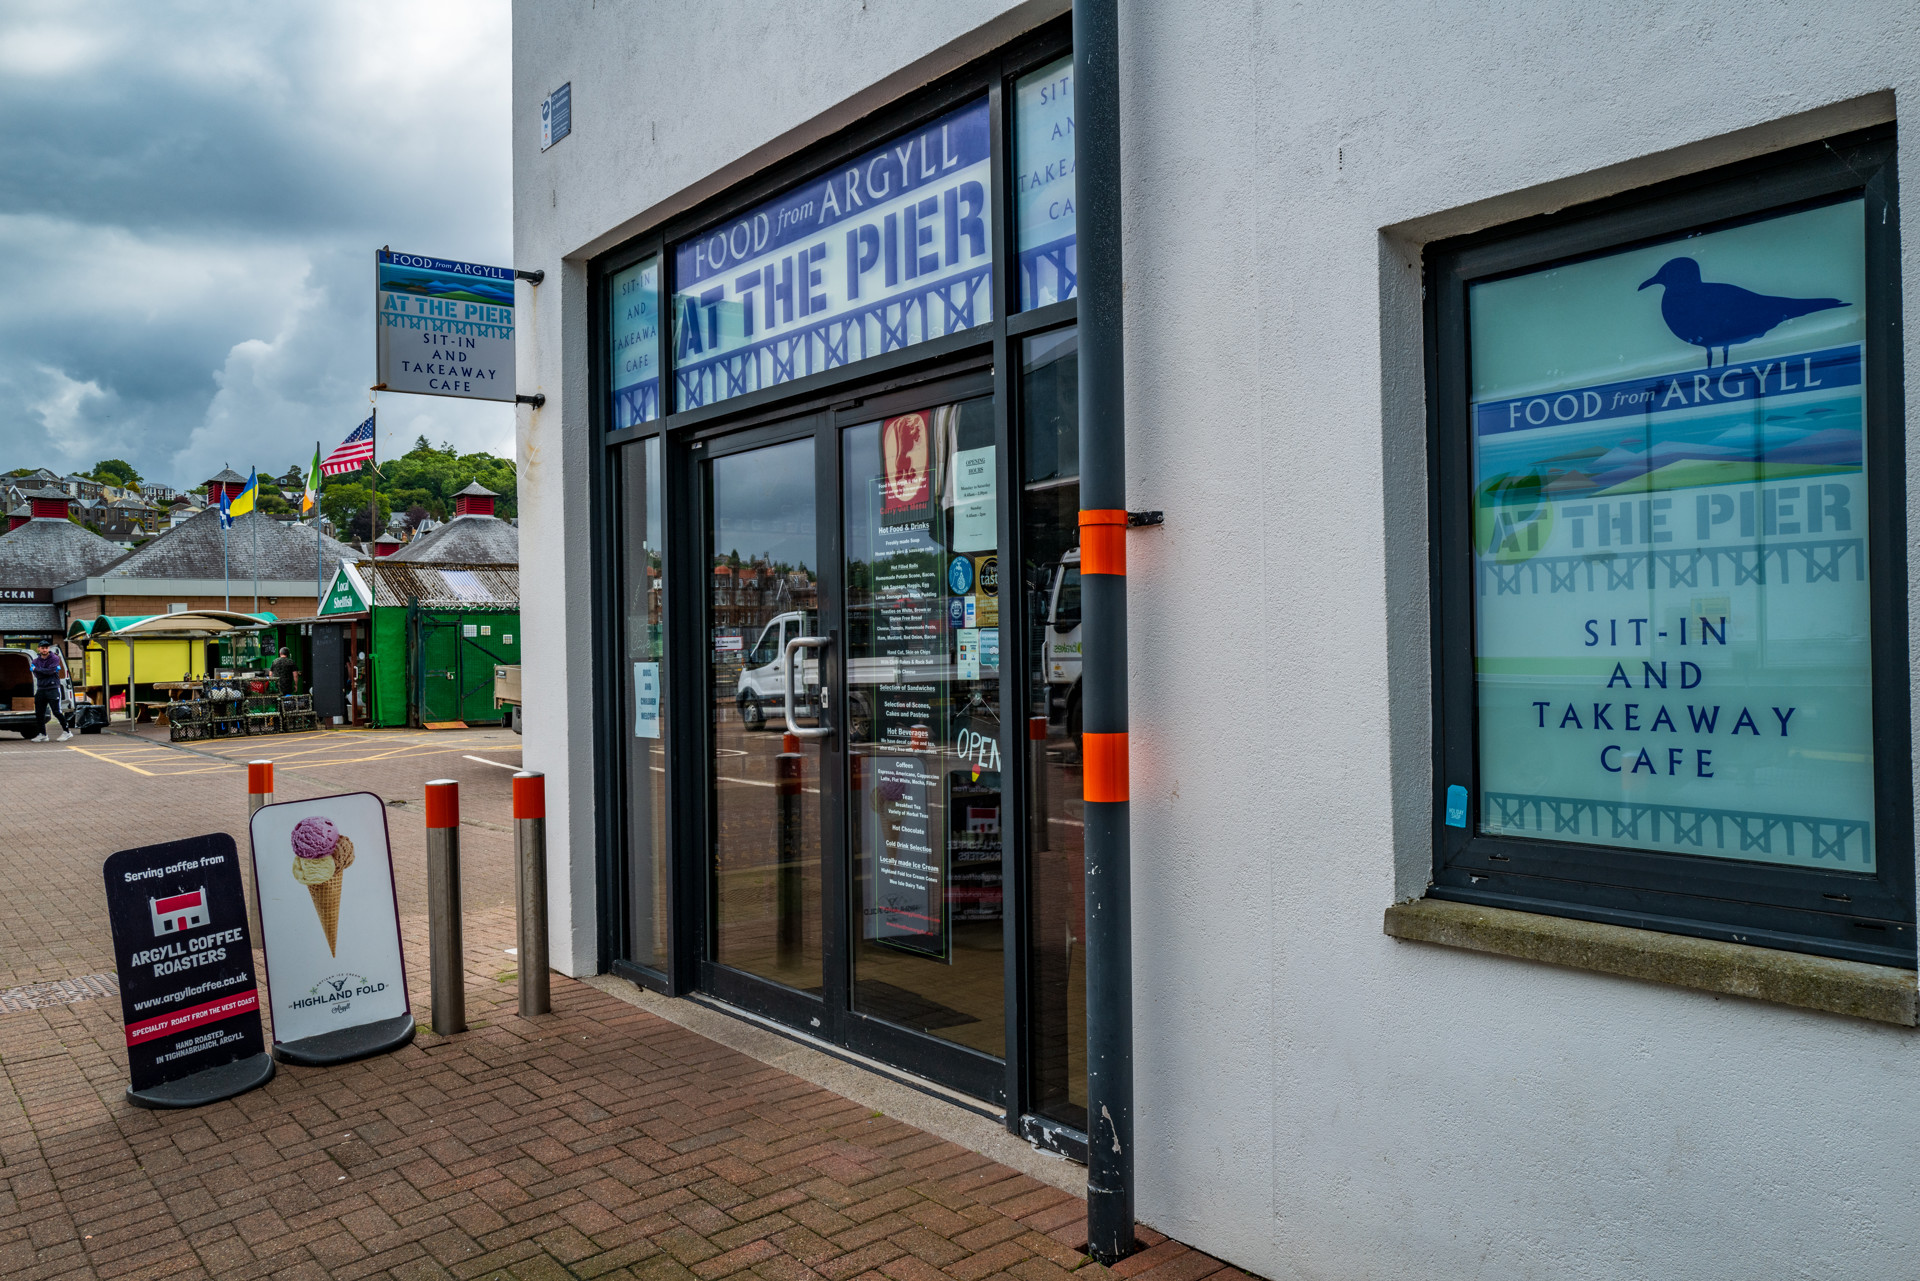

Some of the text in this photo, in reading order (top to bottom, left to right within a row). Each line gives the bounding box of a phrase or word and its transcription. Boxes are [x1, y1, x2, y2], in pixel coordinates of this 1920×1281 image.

[1040, 77, 1069, 106] SIT
[1051, 116, 1075, 141] AN
[1018, 158, 1075, 193] TAKE
[695, 124, 959, 279] FOOD from ARGYLL
[1049, 197, 1074, 220] CA
[393, 253, 504, 279] FOOD from ARGYLL
[678, 180, 987, 361] AT THE PIER
[622, 271, 651, 296] SIT-IN
[384, 294, 512, 325] AT THE PIER
[627, 302, 646, 320] AND
[423, 333, 476, 349] SIT-IN
[613, 326, 657, 350] TAKEAWA
[432, 350, 467, 362] AND
[626, 354, 649, 373] CAFE
[402, 360, 496, 380] TAKEAWAY
[429, 378, 471, 392] CAFE
[1509, 357, 1823, 429] FOOD from ARGYLL
[966, 458, 985, 466] OPENING
[968, 467, 984, 475] HOURS
[880, 506, 896, 515] Carry
[897, 504, 909, 512] Out
[1488, 482, 1853, 555] AT THE PIER
[890, 524, 903, 532] Food
[911, 522, 929, 530] Drinks
[337, 580, 350, 592] Local
[980, 574, 998, 585] tast
[334, 595, 352, 608] Shellfish
[1584, 616, 1727, 647] SIT-IN
[1606, 661, 1703, 690] AND
[1532, 701, 1796, 737] TAKEAWAY
[899, 728, 928, 738] Beverages
[958, 728, 1001, 773] OPEN
[1600, 745, 1715, 779] CAFE
[901, 826, 924, 835] Chocolate
[910, 844, 932, 853] Selection
[124, 855, 225, 882] Serving coffee from
[880, 856, 897, 865] Locally
[922, 864, 939, 872] Cream
[131, 927, 244, 968] ARGYLL COFFEE
[153, 948, 227, 978] ROASTERS
[134, 972, 248, 1012] www.argyllcoffee.co.uk
[293, 982, 385, 1010] HIGHLAND FOLD
[132, 1021, 168, 1037] SPECIALITY
[171, 1015, 191, 1026] ROAST
[192, 1010, 208, 1020] FROM
[209, 1006, 220, 1015] THE
[238, 996, 256, 1007] COAST
[156, 1032, 244, 1064] IN TIGHNABRUAICH, ARGYLL
[175, 1030, 224, 1050] HAND ROASTED
